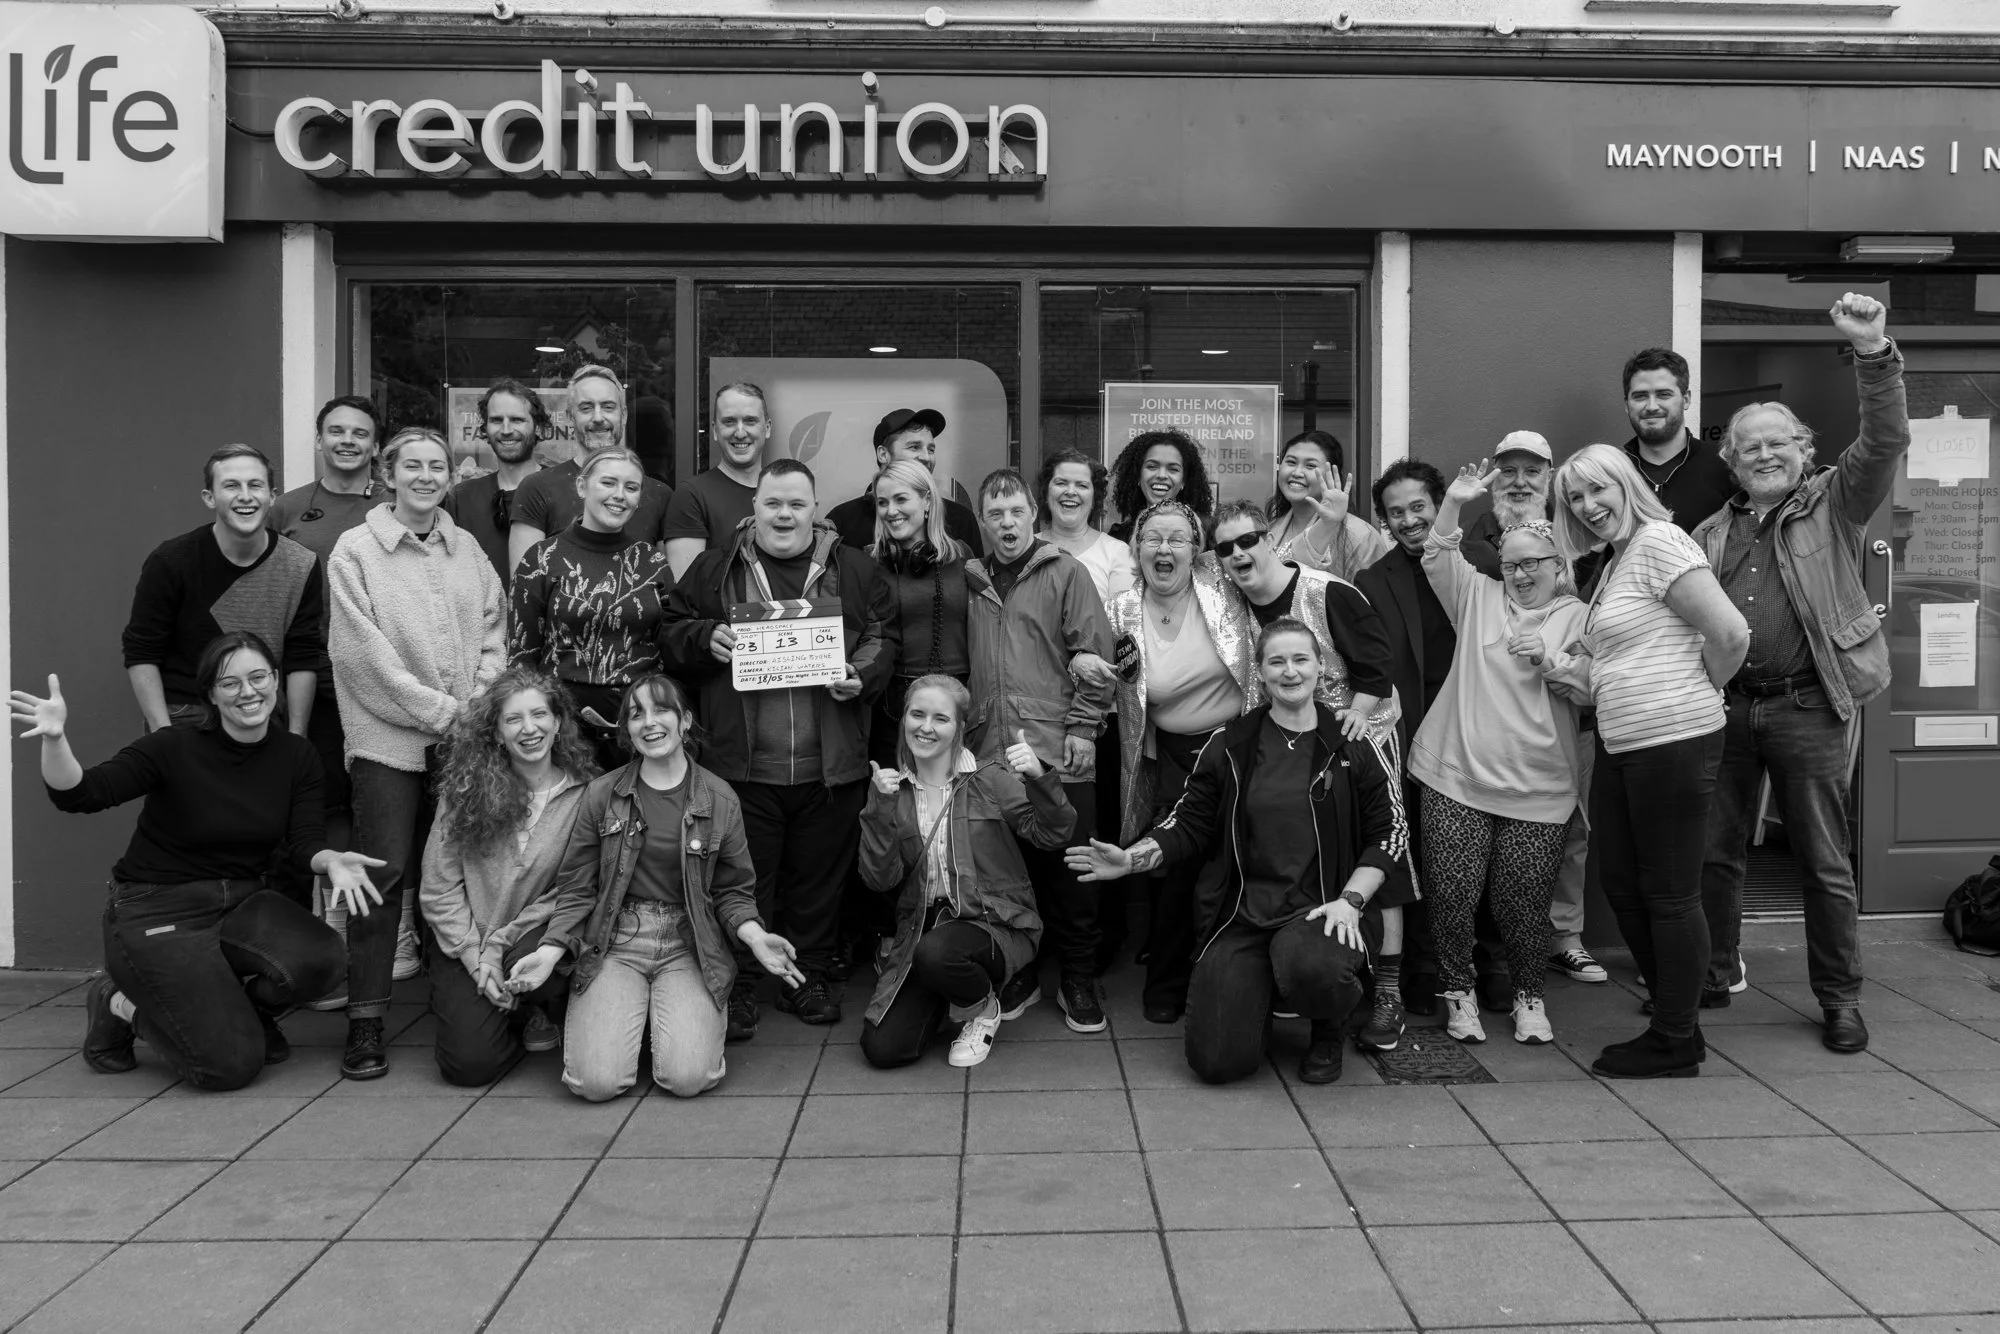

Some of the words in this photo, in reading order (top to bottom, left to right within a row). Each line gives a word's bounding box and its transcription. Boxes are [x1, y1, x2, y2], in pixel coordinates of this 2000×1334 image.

[275, 59, 652, 179] credit
[696, 71, 1048, 181] union
[1606, 143, 1782, 169] MAYNOOTH
[1843, 145, 1926, 170] NAAS
[1140, 398, 1171, 410] JOIN
[1174, 398, 1201, 410] THE
[1204, 399, 1244, 411] MOST
[1130, 413, 1192, 425] TRUSTED
[1194, 414, 1253, 426] FINANCE
[1197, 428, 1255, 440] IRELAND
[1926, 437, 1976, 453] CLOSED
[1220, 448, 1247, 460] THE
[1910, 487, 1959, 497] OPENING
[1961, 487, 1999, 497] HOURS
[1924, 501, 1949, 510] Mon:
[1952, 501, 1984, 510] Closed
[1932, 515, 1966, 524] 9.30am
[1978, 515, 1999, 524] 5pm
[1924, 528, 1948, 537] Wed:
[1951, 527, 1984, 537] Closed
[1924, 541, 1948, 550] Thur:
[1951, 541, 1983, 550] Closed
[1911, 555, 1926, 563] Fri:
[1928, 554, 1963, 564] 9.30am
[1976, 554, 1996, 564] 5pm
[1927, 568, 1945, 577] Sat:
[1947, 567, 1979, 577] Closed
[775, 637, 798, 649] 13
[815, 634, 837, 643] 04
[736, 642, 758, 652] 03
[757, 674, 783, 685] 18/05
